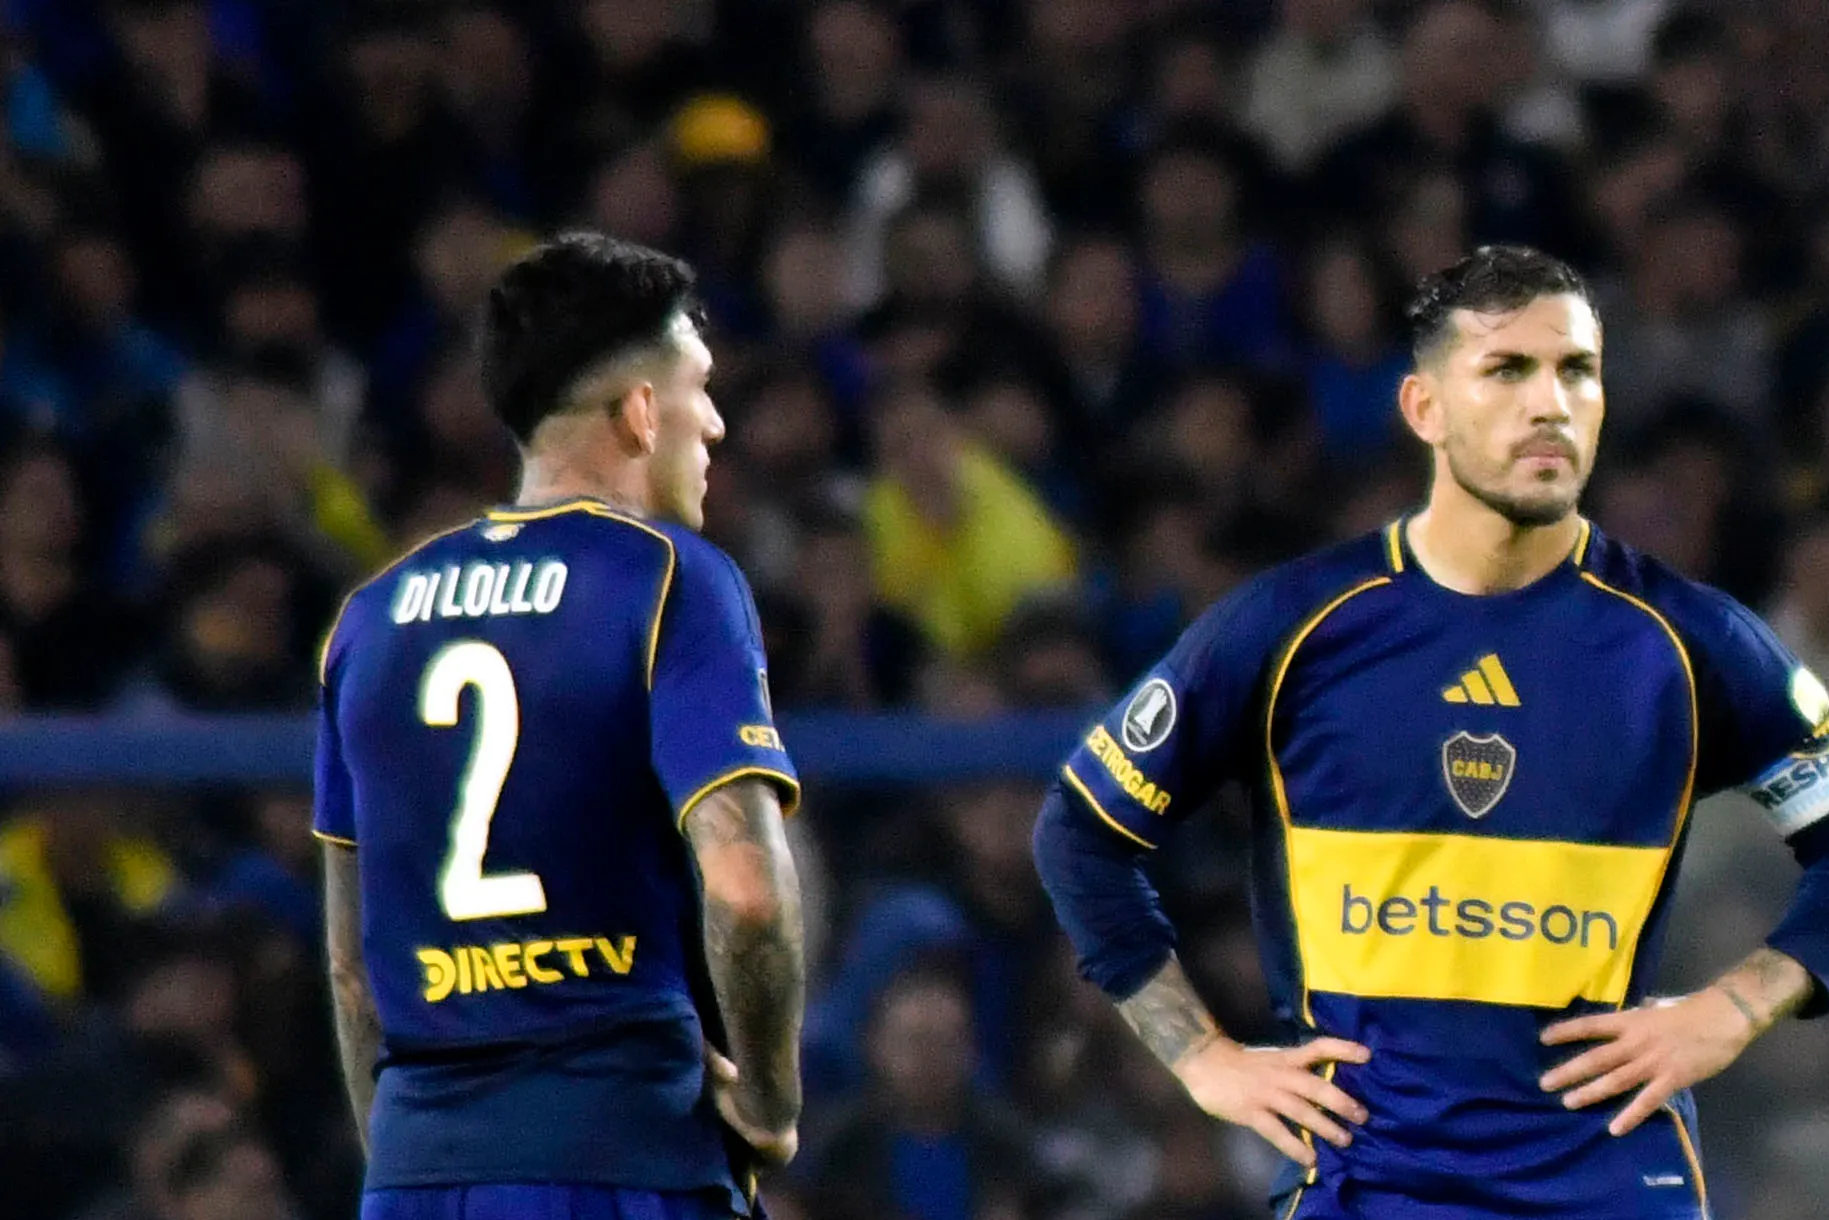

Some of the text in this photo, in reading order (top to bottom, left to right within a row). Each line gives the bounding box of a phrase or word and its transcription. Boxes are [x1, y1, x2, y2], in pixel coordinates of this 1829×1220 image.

[393, 561, 569, 625] DI LOLLO
[423, 641, 547, 921] 2
[1341, 883, 1617, 950] betsson
[416, 935, 637, 1003] DIRECTV
